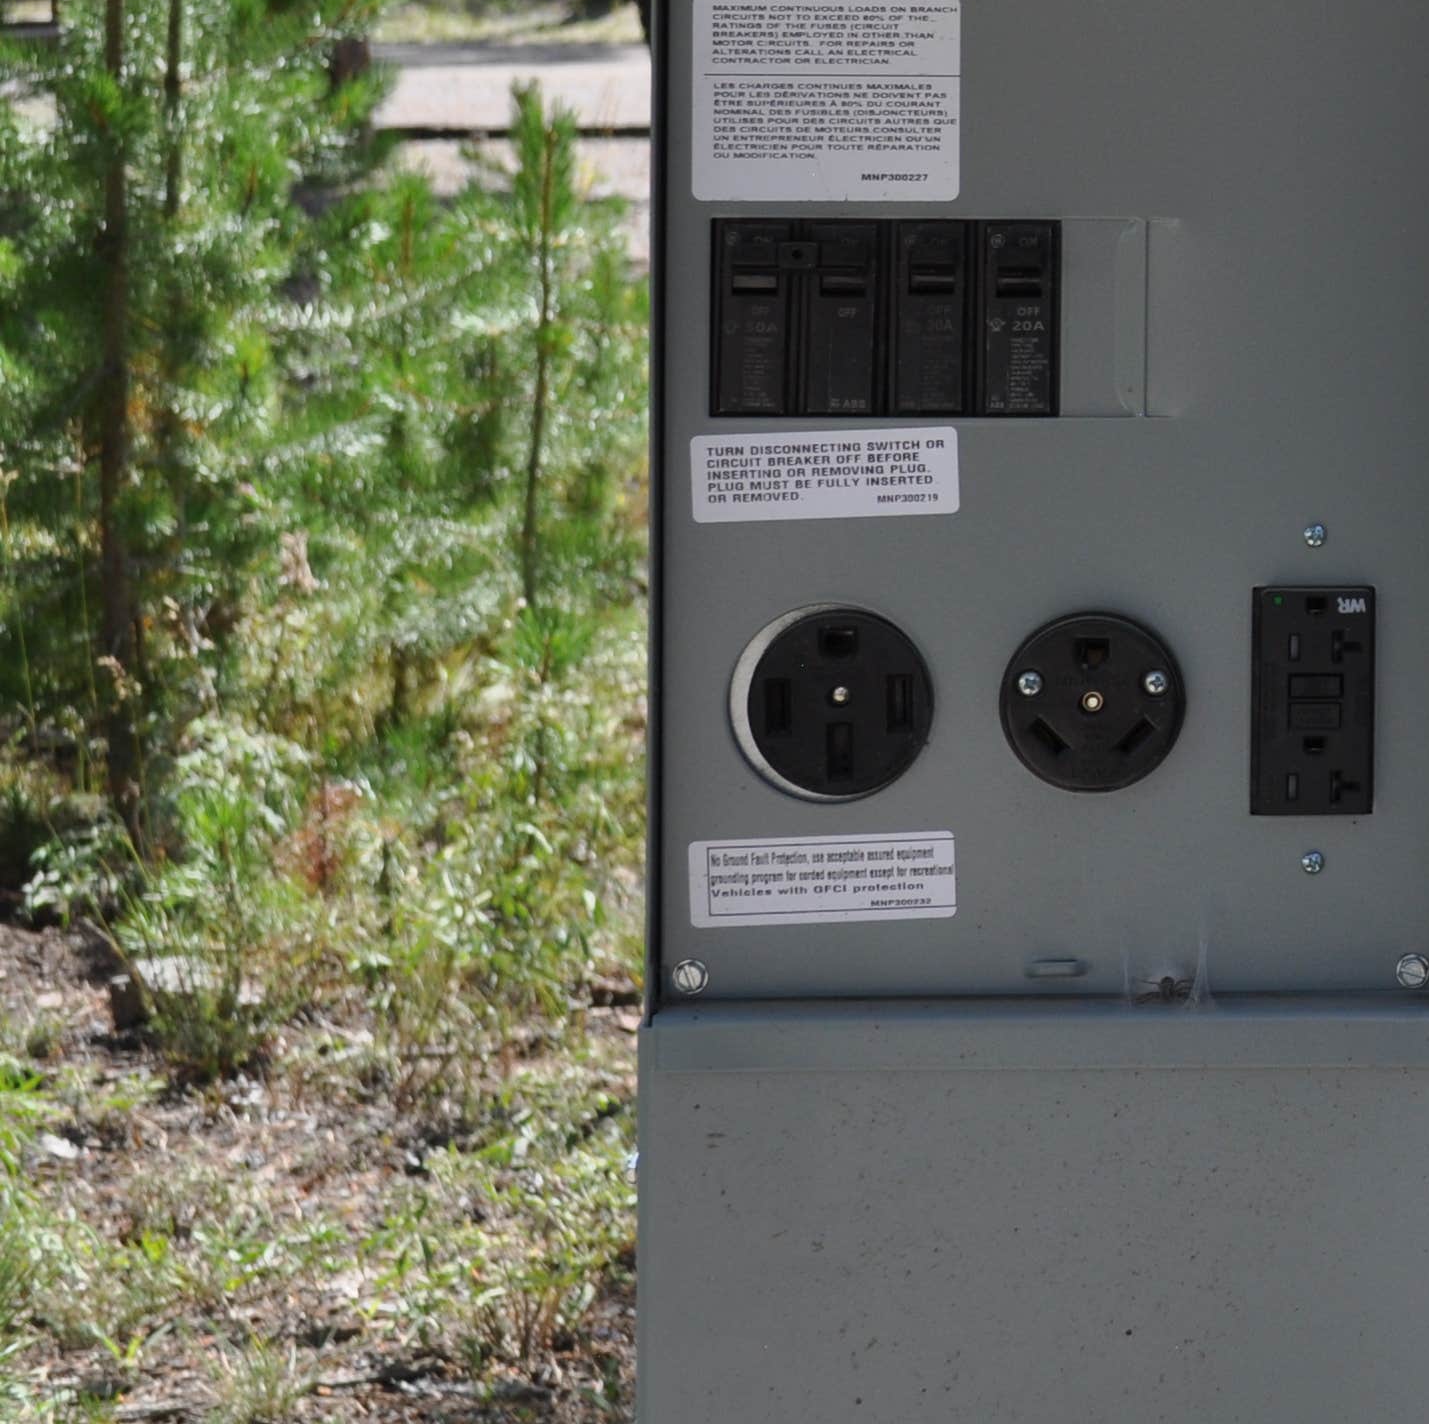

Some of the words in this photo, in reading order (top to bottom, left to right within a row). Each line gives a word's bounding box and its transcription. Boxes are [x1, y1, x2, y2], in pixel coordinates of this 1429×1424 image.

[712, 5, 767, 13] MAXIMUM
[770, 5, 844, 13] CONTINUOUS
[848, 5, 887, 13] LOADS
[890, 5, 906, 13] ON
[910, 5, 957, 13] BRANCH
[712, 14, 765, 22] CIRCUITS
[768, 14, 792, 22] NOT
[796, 14, 811, 22] TO
[814, 14, 860, 22] EXCEED
[889, 14, 903, 22] OF
[907, 14, 929, 22] THE
[712, 31, 778, 39] BREAKERS)
[782, 31, 844, 39] EMPLOYED
[848, 31, 858, 39] IN
[862, 31, 900, 39] OTHER
[904, 31, 934, 39] THAN
[712, 40, 753, 48] MOTOR
[819, 40, 842, 48] FOR
[846, 40, 895, 48] REPAIRS
[899, 40, 915, 48] OR
[712, 48, 791, 56] ALTERATIONS
[795, 48, 824, 56] CALL
[828, 48, 843, 56] AN
[847, 48, 918, 56] ELECTRICAL
[712, 57, 791, 65] CONTRACTOR
[794, 57, 810, 65] OR
[713, 91, 745, 99] POUR
[749, 91, 770, 99] LES
[774, 91, 850, 99] DÉRIVATIONS
[853, 91, 869, 99] NE
[872, 91, 921, 99] DOIVENT
[925, 91, 947, 99] PAS
[867, 99, 882, 108] DU
[886, 99, 941, 108] COURANT
[769, 109, 791, 117] DES
[795, 109, 850, 117] FUSIBLES
[853, 109, 948, 117] (DISJONCTEURS)
[767, 117, 799, 125] POUR
[802, 117, 825, 125] DES
[829, 117, 881, 125] CIRCUITS
[885, 117, 929, 125] AUTRES
[933, 117, 957, 125] QUE
[713, 126, 736, 134] DES
[739, 126, 792, 134] CIRCUITS
[795, 126, 811, 134] DE
[872, 126, 942, 134] CONSULTER
[713, 135, 729, 143] UN
[733, 135, 824, 143] ENTREPRENEUR
[791, 143, 823, 151] POUR
[826, 143, 863, 151] TOUTE
[713, 152, 730, 160] OU
[861, 173, 928, 182] MNP300227
[1016, 307, 1041, 317] OFF
[1012, 320, 1045, 331] 20A
[707, 446, 744, 457] TURN
[750, 442, 861, 456] DISCONNECTING
[867, 440, 920, 451] SWITCH
[926, 439, 945, 449] OR
[707, 457, 761, 469] CIRCUIT
[767, 455, 830, 467] BREAKER
[837, 454, 861, 465] OFF
[867, 452, 920, 463] BEFORE
[707, 468, 781, 481] INSERTING
[787, 467, 805, 478] OR
[812, 465, 885, 477] REMOVING
[890, 463, 931, 474] PLUG.
[708, 481, 744, 493] PLUG
[750, 479, 788, 491] MUST
[795, 478, 812, 489] BE
[818, 477, 860, 488] FULLY
[866, 475, 933, 486] INSERTED
[708, 493, 727, 504] OR
[877, 493, 939, 504] MNP300219
[1337, 597, 1366, 613] WR
[710, 853, 722, 866] No
[723, 852, 749, 866] Ground
[750, 851, 770, 865] Fault
[812, 853, 824, 864] use
[826, 849, 865, 865] acceptable
[897, 846, 934, 861] equipment
[710, 872, 749, 887] grounding
[751, 872, 784, 885] program
[785, 871, 797, 881] for
[798, 869, 825, 881] corded
[827, 867, 868, 880] equipment
[870, 866, 896, 879] except
[897, 866, 907, 877] for
[711, 887, 772, 898] Vehicles
[778, 885, 807, 896] with
[813, 883, 847, 894] GFCI
[853, 881, 924, 894] protection
